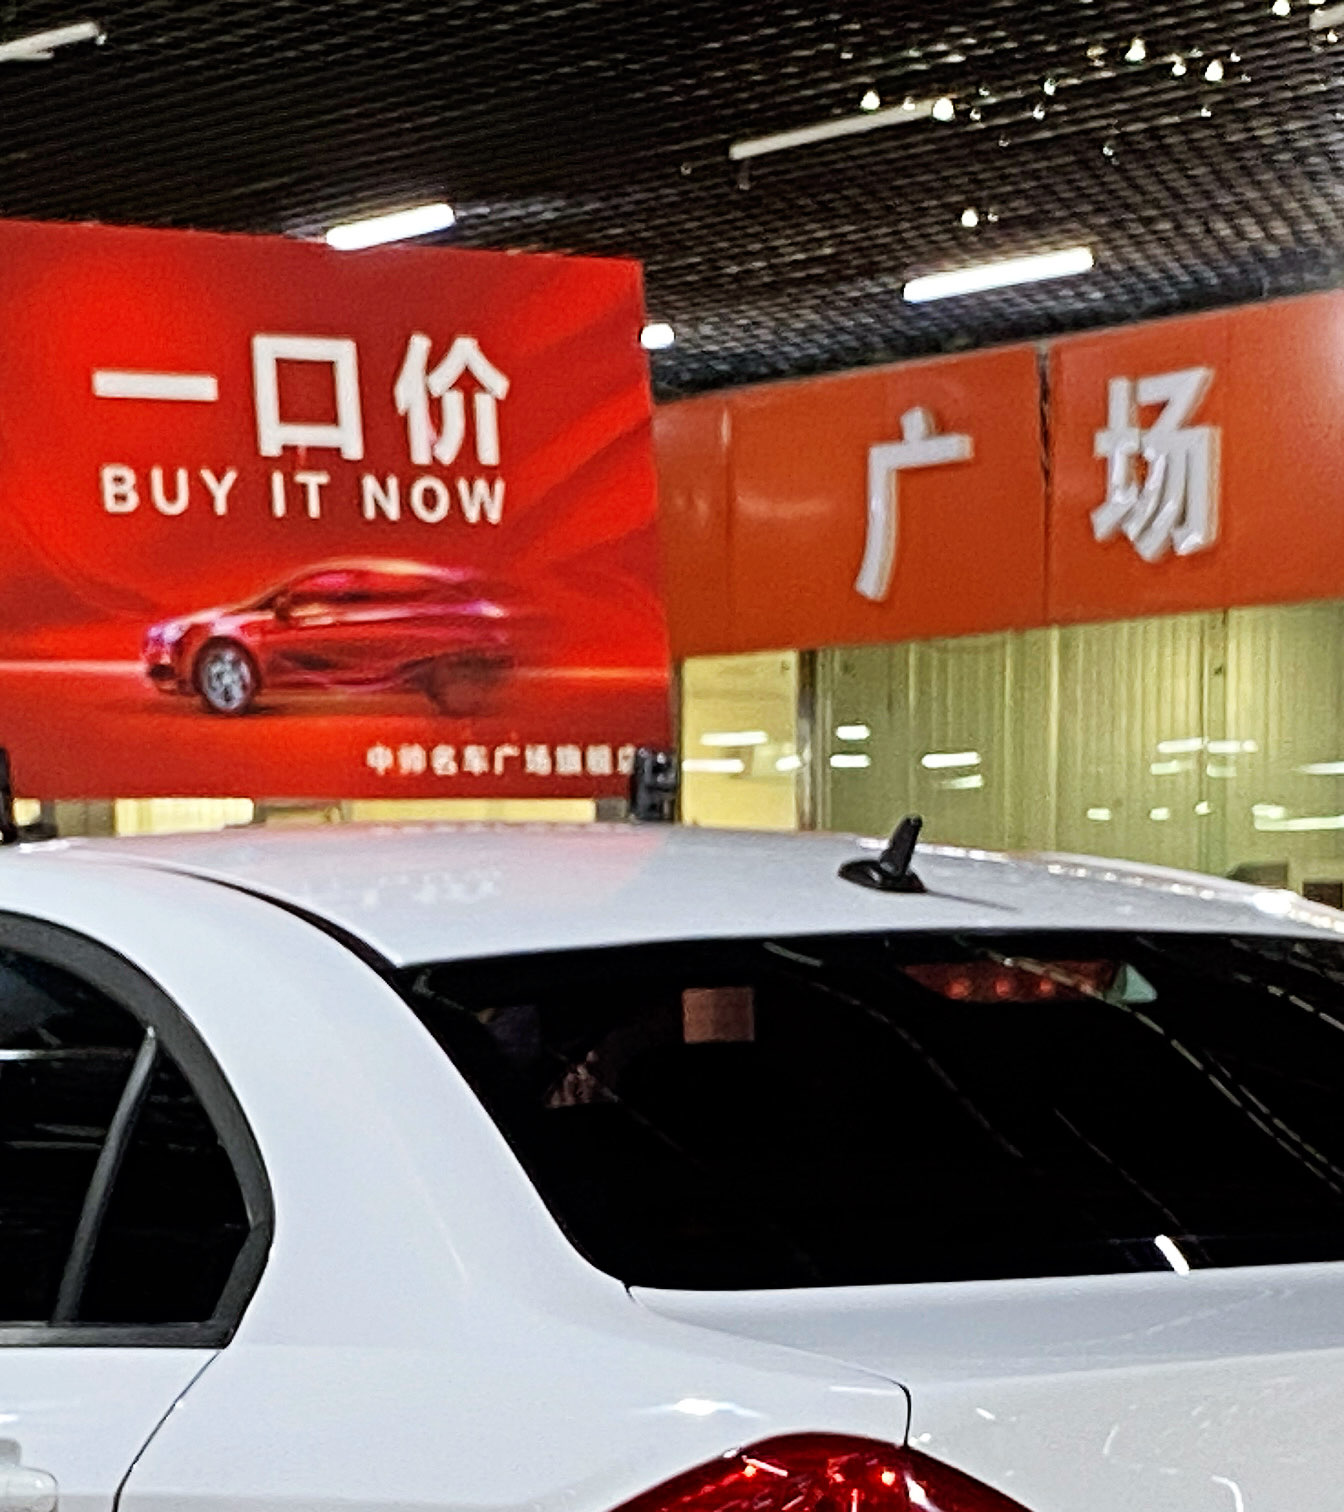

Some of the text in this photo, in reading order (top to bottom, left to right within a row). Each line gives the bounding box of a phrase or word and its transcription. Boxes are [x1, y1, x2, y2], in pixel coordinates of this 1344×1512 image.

[92, 332, 510, 466] 一口价
[100, 463, 506, 525] BUY IT NOW
[856, 366, 1221, 600] 广场
